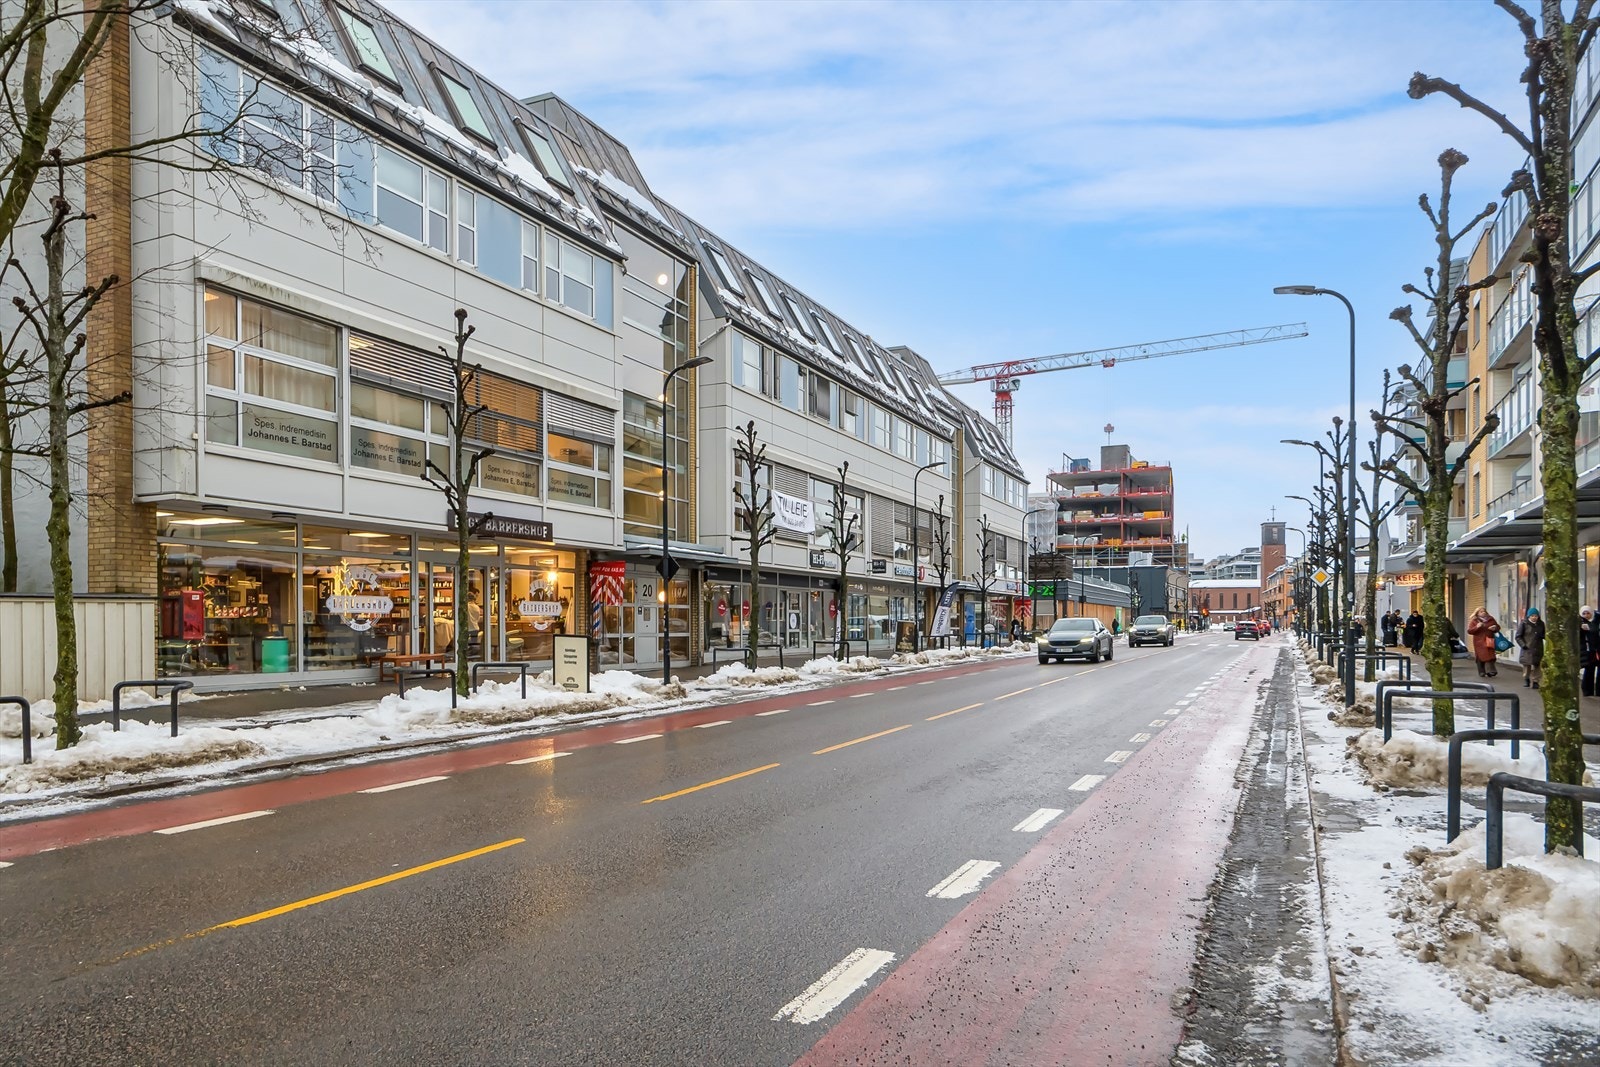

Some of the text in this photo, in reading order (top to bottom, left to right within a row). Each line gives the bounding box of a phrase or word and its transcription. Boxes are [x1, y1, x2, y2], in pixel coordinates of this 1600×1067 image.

[248, 429, 332, 451] Johannes E. Barstad
[280, 423, 326, 440] indremedisin
[353, 449, 386, 461] Johannes
[397, 457, 421, 467] Barstad
[379, 444, 416, 457] indremedisin
[484, 473, 509, 484] Johannes
[516, 479, 535, 488] Barstad
[791, 500, 807, 518] LEIE
[486, 520, 548, 538] BARBERSHOP
[642, 584, 652, 597] 20
